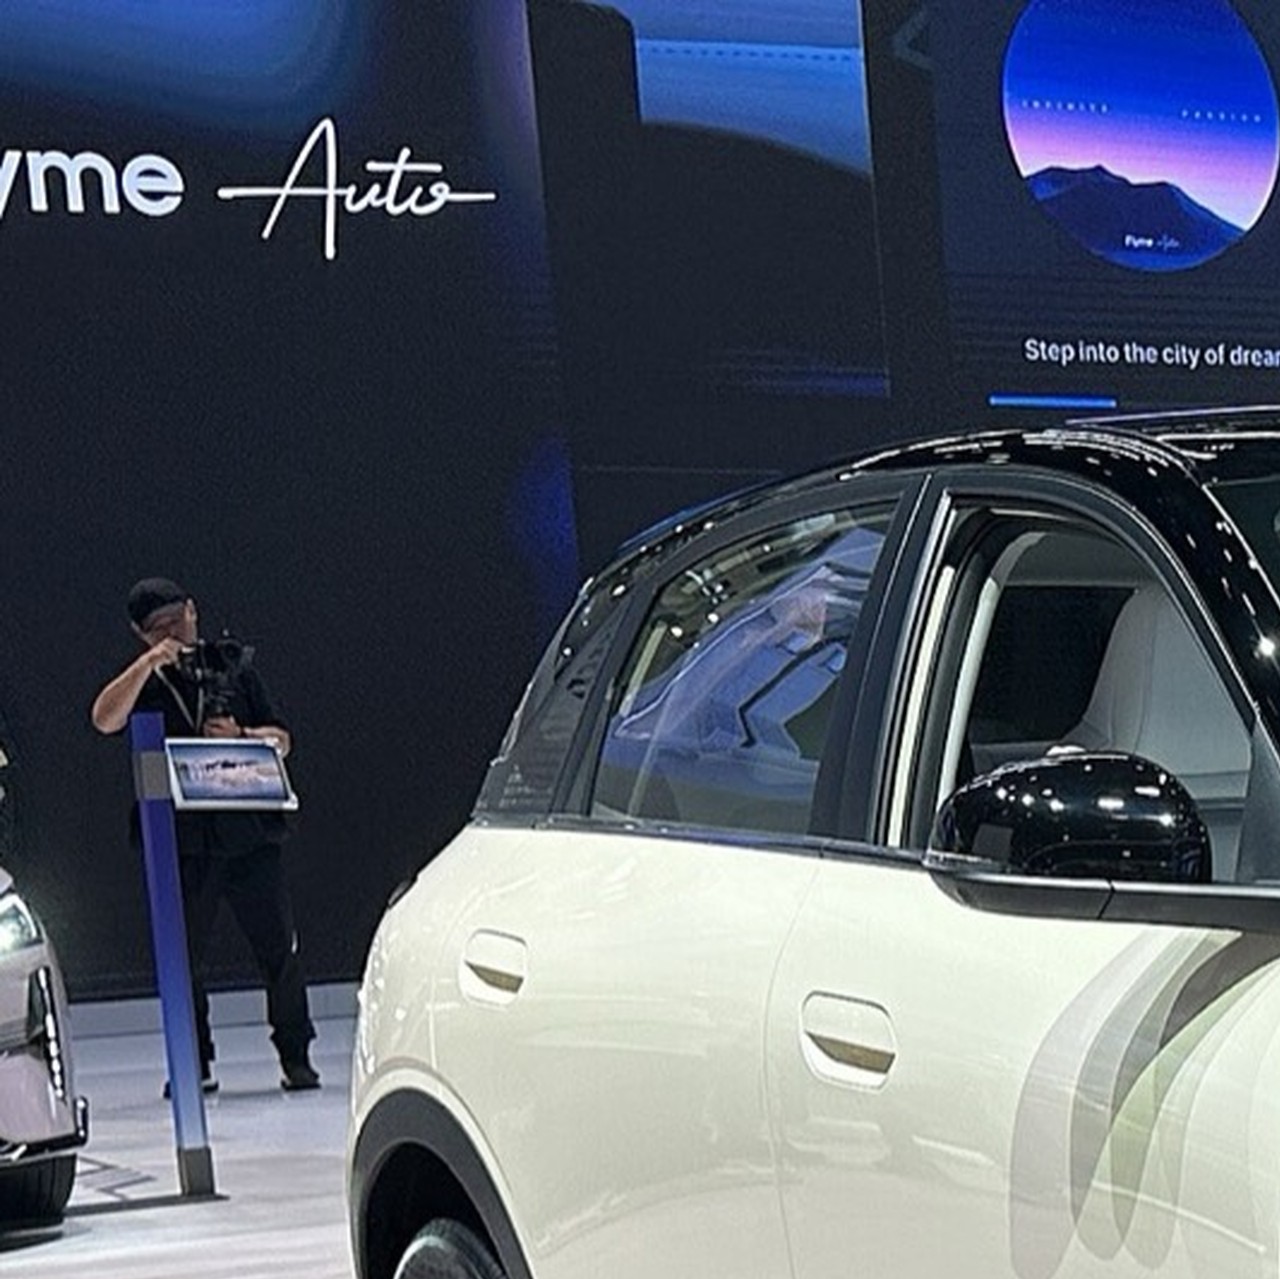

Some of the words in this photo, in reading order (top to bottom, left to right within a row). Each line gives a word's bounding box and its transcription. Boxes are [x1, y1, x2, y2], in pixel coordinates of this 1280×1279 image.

[217, 117, 496, 260] Auto
[1025, 338, 1075, 366] Step
[1078, 340, 1119, 362] into
[1123, 341, 1158, 363] the
[1162, 343, 1200, 369] city
[1204, 344, 1225, 366] of
